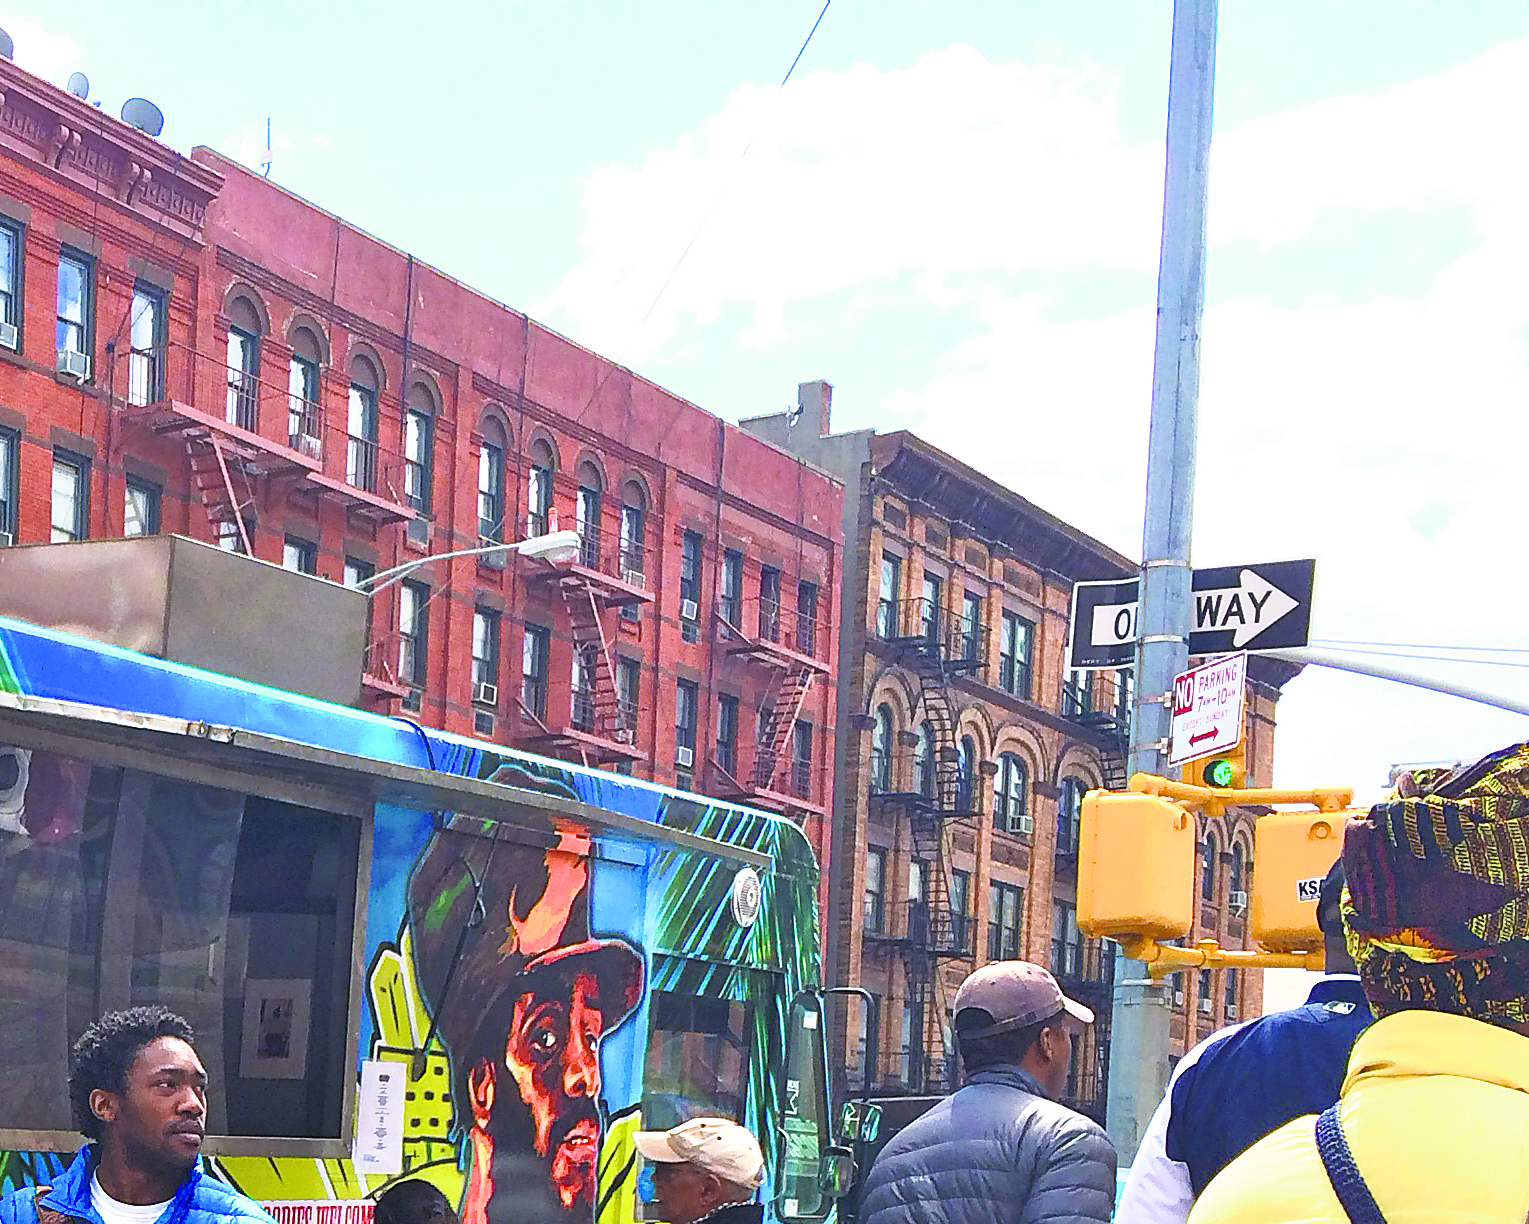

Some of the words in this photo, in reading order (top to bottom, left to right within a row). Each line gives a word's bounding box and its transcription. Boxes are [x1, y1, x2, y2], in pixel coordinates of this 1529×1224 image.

[1196, 590, 1273, 629] WAY
[1175, 677, 1195, 712] NO
[1199, 663, 1237, 694] PARKING
